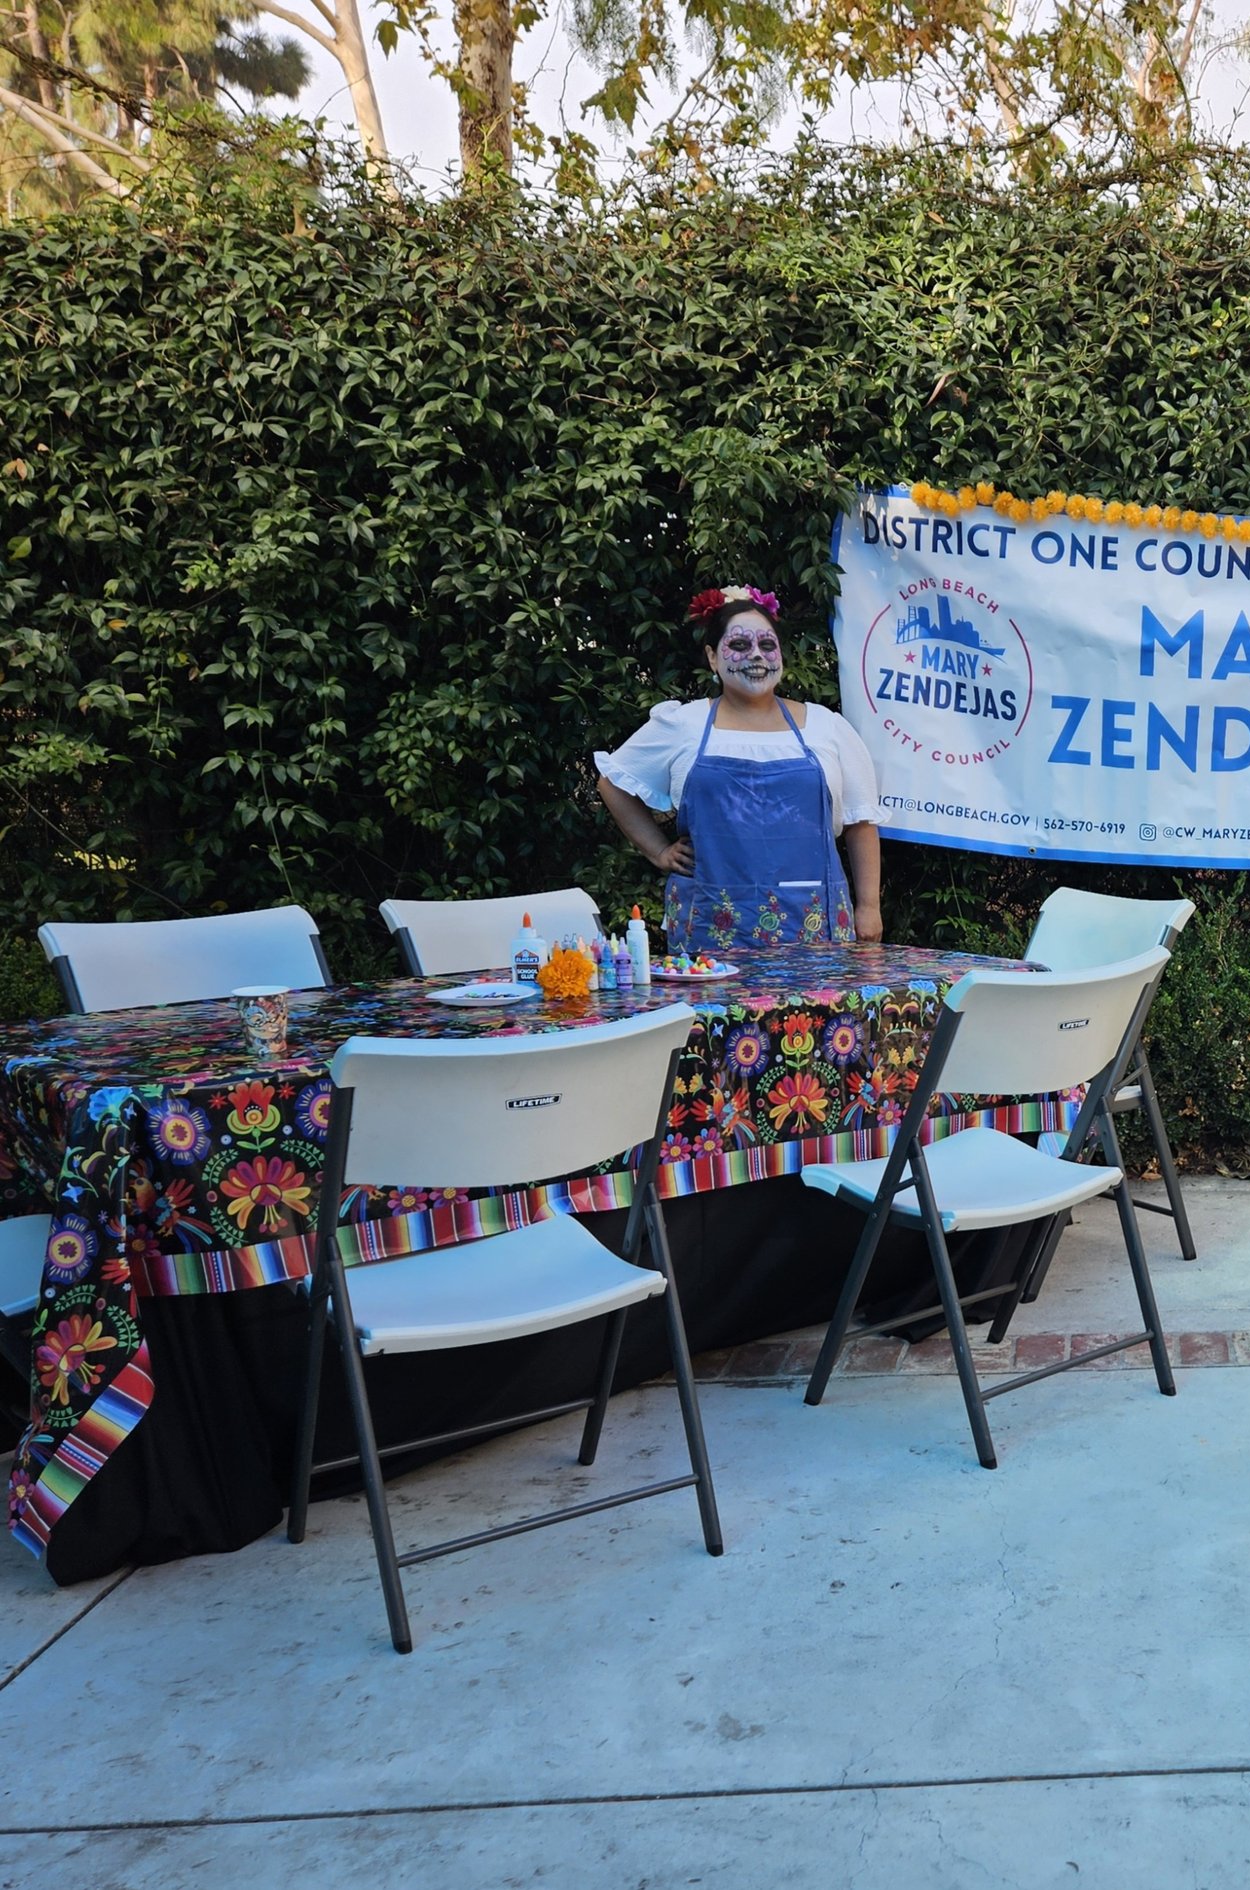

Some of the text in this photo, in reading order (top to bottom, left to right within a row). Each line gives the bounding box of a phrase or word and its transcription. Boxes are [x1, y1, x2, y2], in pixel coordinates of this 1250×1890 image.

[862, 510, 1017, 559] DISTRICT
[1031, 530, 1119, 571] ONE
[899, 577, 999, 614] LONG BEACH
[921, 644, 979, 680] MARY
[876, 667, 1017, 721] ZENDEJAS
[883, 719, 1010, 765] CITY COUNCIL
[1043, 817, 1126, 835] 562-570-6919
[512, 1096, 555, 1107] LIFETIME
